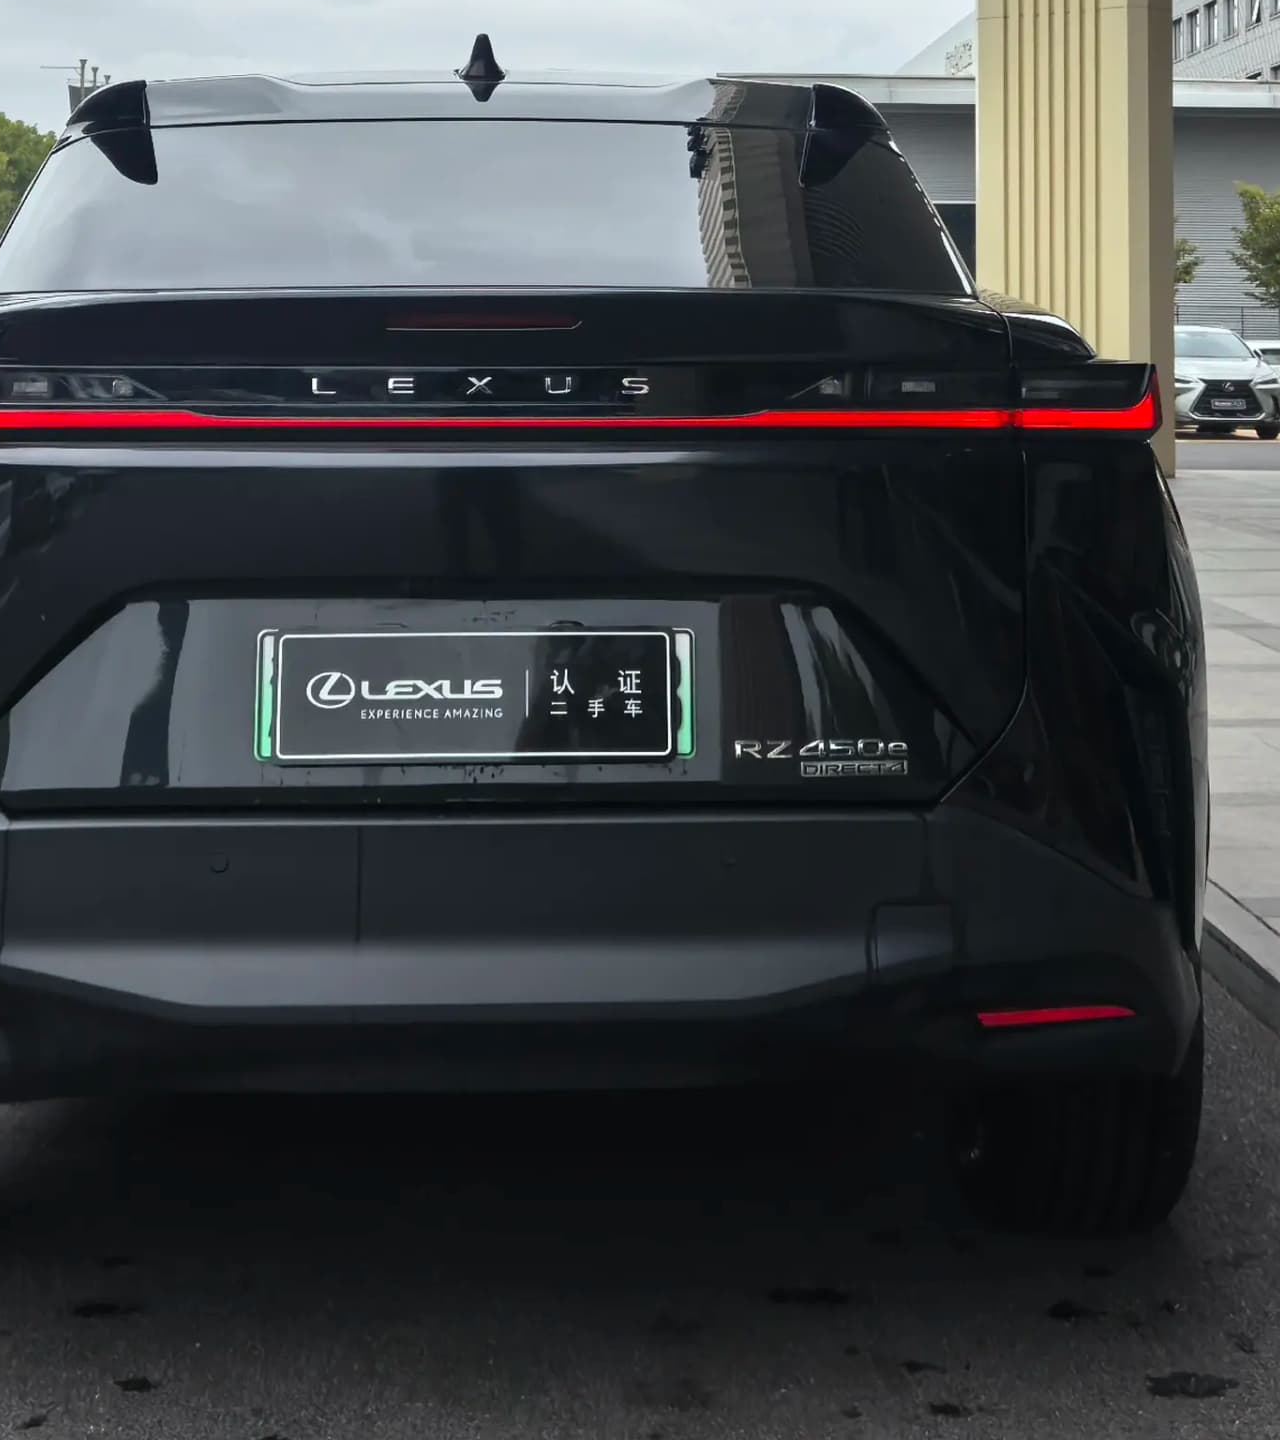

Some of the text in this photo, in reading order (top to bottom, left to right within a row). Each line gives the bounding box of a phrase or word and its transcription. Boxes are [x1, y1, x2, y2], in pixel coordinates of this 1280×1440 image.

[312, 376, 650, 395] LEXUS
[360, 679, 503, 700] LEXUS
[550, 668, 642, 695] 认证
[360, 708, 504, 720] EXPERIENCE AMAZING
[550, 698, 643, 719] 二手车
[734, 739, 909, 759] RZ 450e
